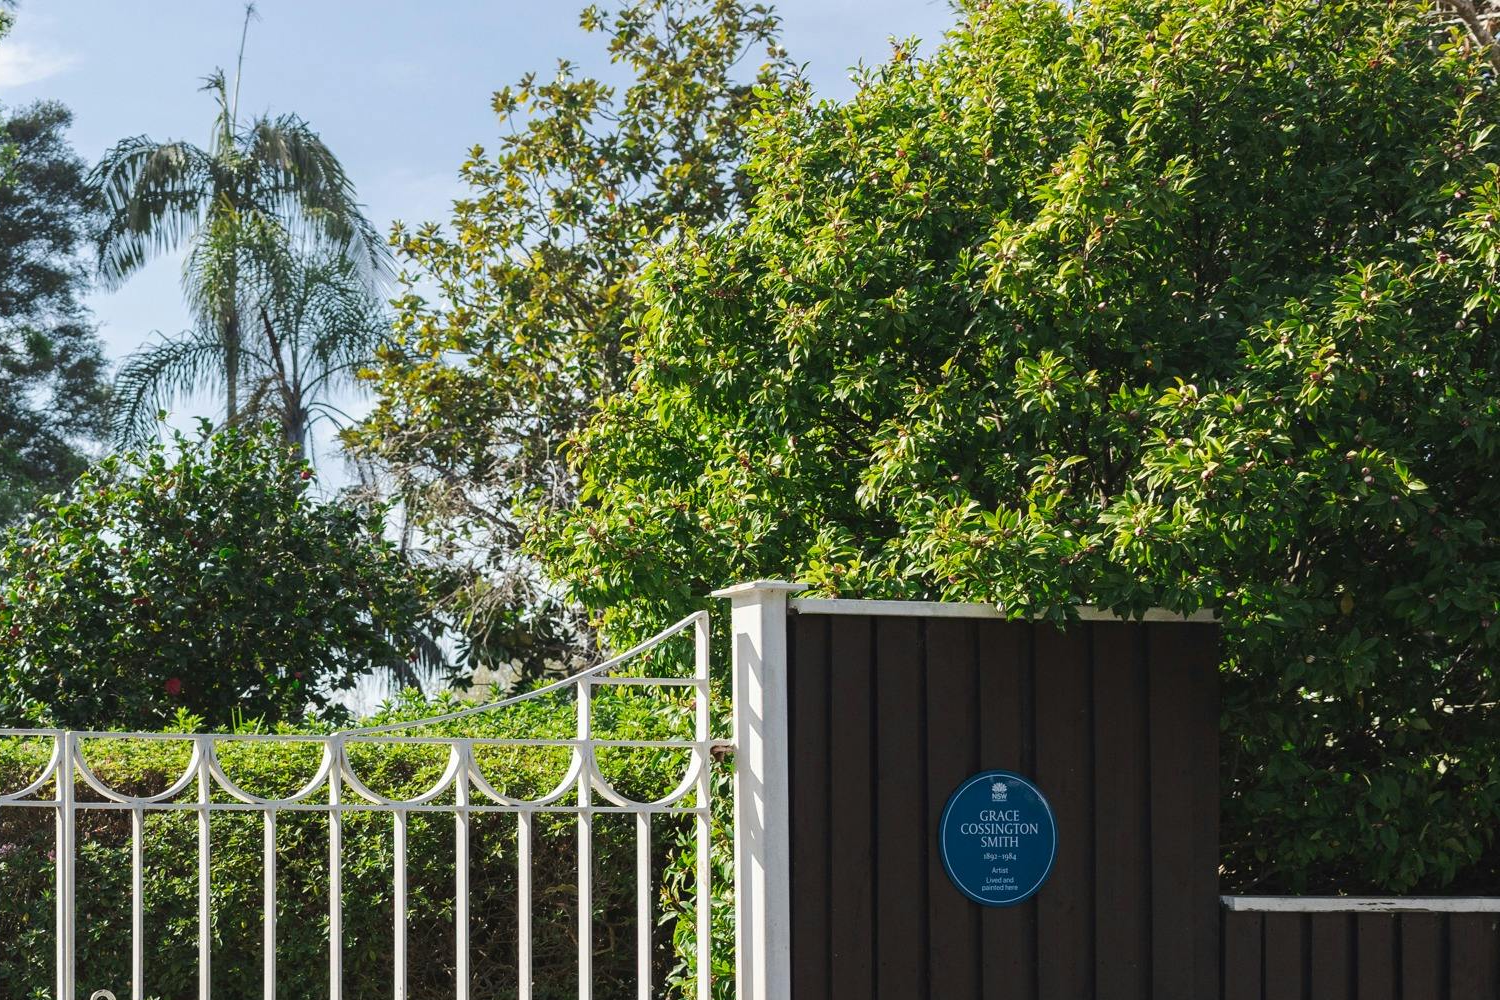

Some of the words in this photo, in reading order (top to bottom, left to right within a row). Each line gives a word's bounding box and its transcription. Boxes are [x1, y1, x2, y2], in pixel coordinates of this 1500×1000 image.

[979, 810, 1020, 822] GRACE
[960, 823, 1038, 835] COSSINGTON
[981, 836, 1019, 848] SMITH
